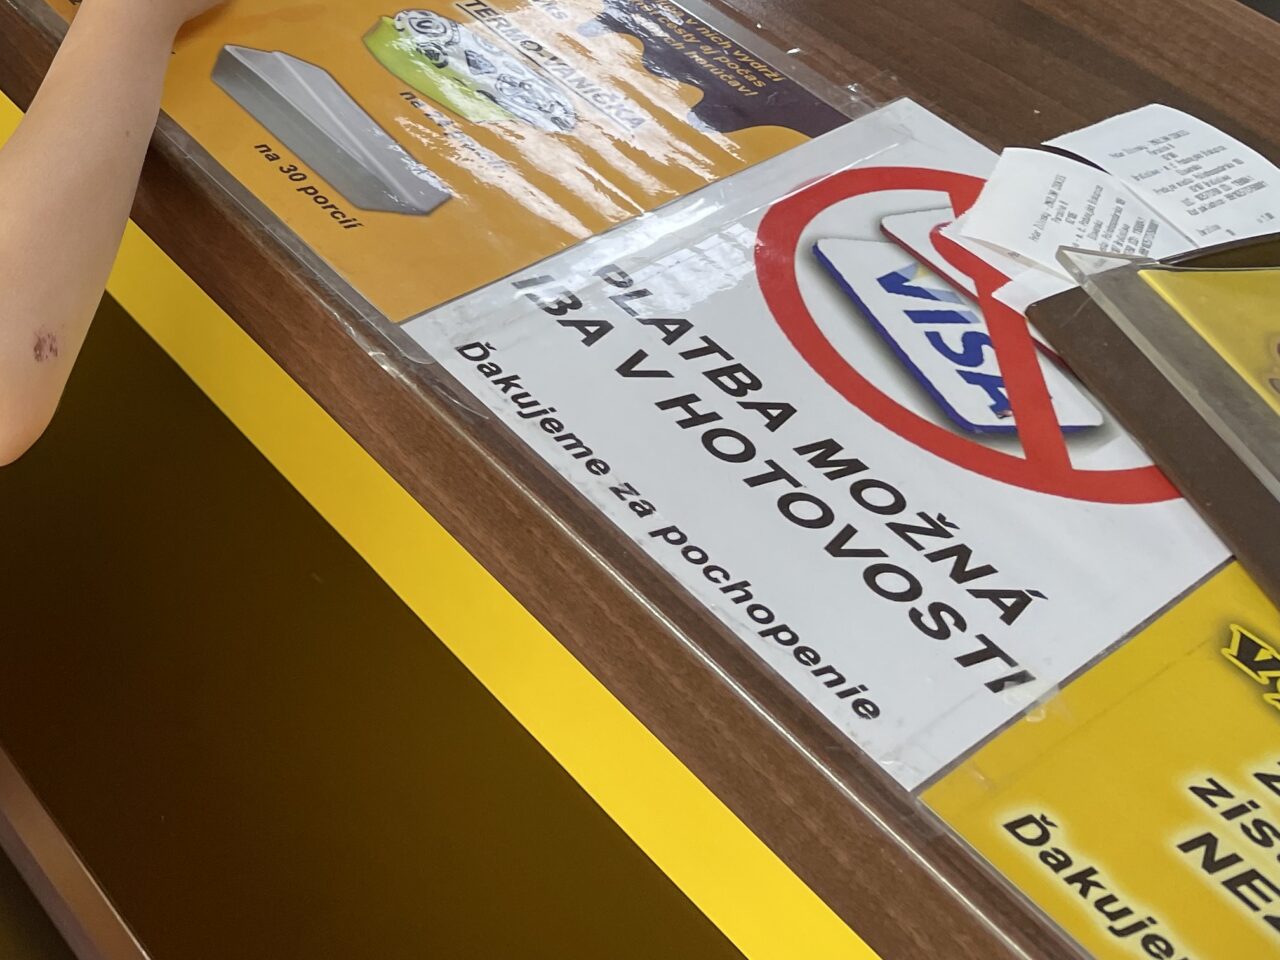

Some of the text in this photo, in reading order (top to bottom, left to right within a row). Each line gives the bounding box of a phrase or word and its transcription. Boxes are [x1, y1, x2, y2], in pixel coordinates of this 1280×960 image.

[657, 15, 702, 44] cesty
[713, 55, 768, 89] počas
[696, 26, 733, 51] nich
[254, 140, 364, 232] na 30 porcií
[453, 339, 882, 723] Ďakujeme za pochopenie
[511, 274, 1037, 694] IBA V HOTOVOSTI
[592, 263, 1050, 627] PLATBA MOŽNÁ
